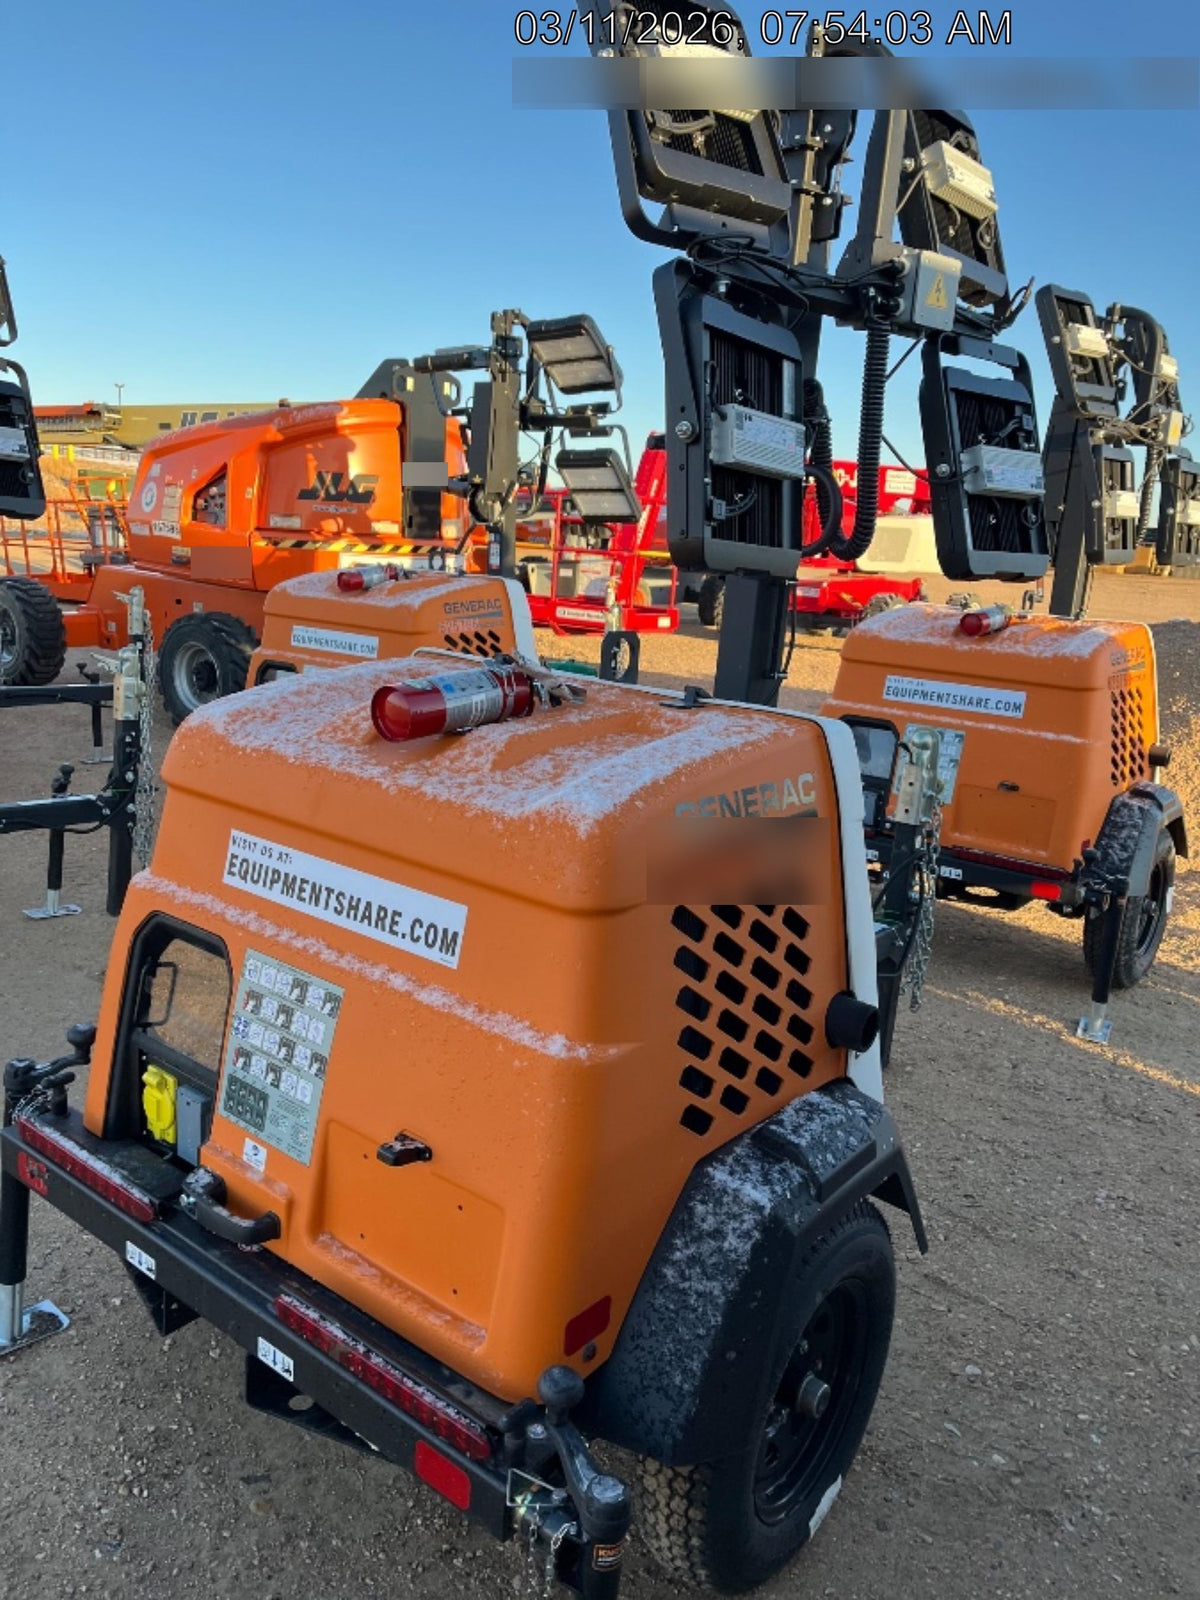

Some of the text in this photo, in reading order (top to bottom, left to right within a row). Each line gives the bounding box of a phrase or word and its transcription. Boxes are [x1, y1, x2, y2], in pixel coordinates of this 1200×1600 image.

[297, 470, 379, 504] JLG
[443, 599, 502, 614] GENERAC
[885, 685, 1023, 714] EQUIPMENTSHARE.COM
[231, 834, 258, 854] VISIT
[277, 852, 293, 865] AT:
[226, 852, 460, 958] EQUIPMENTSHARE.COM
